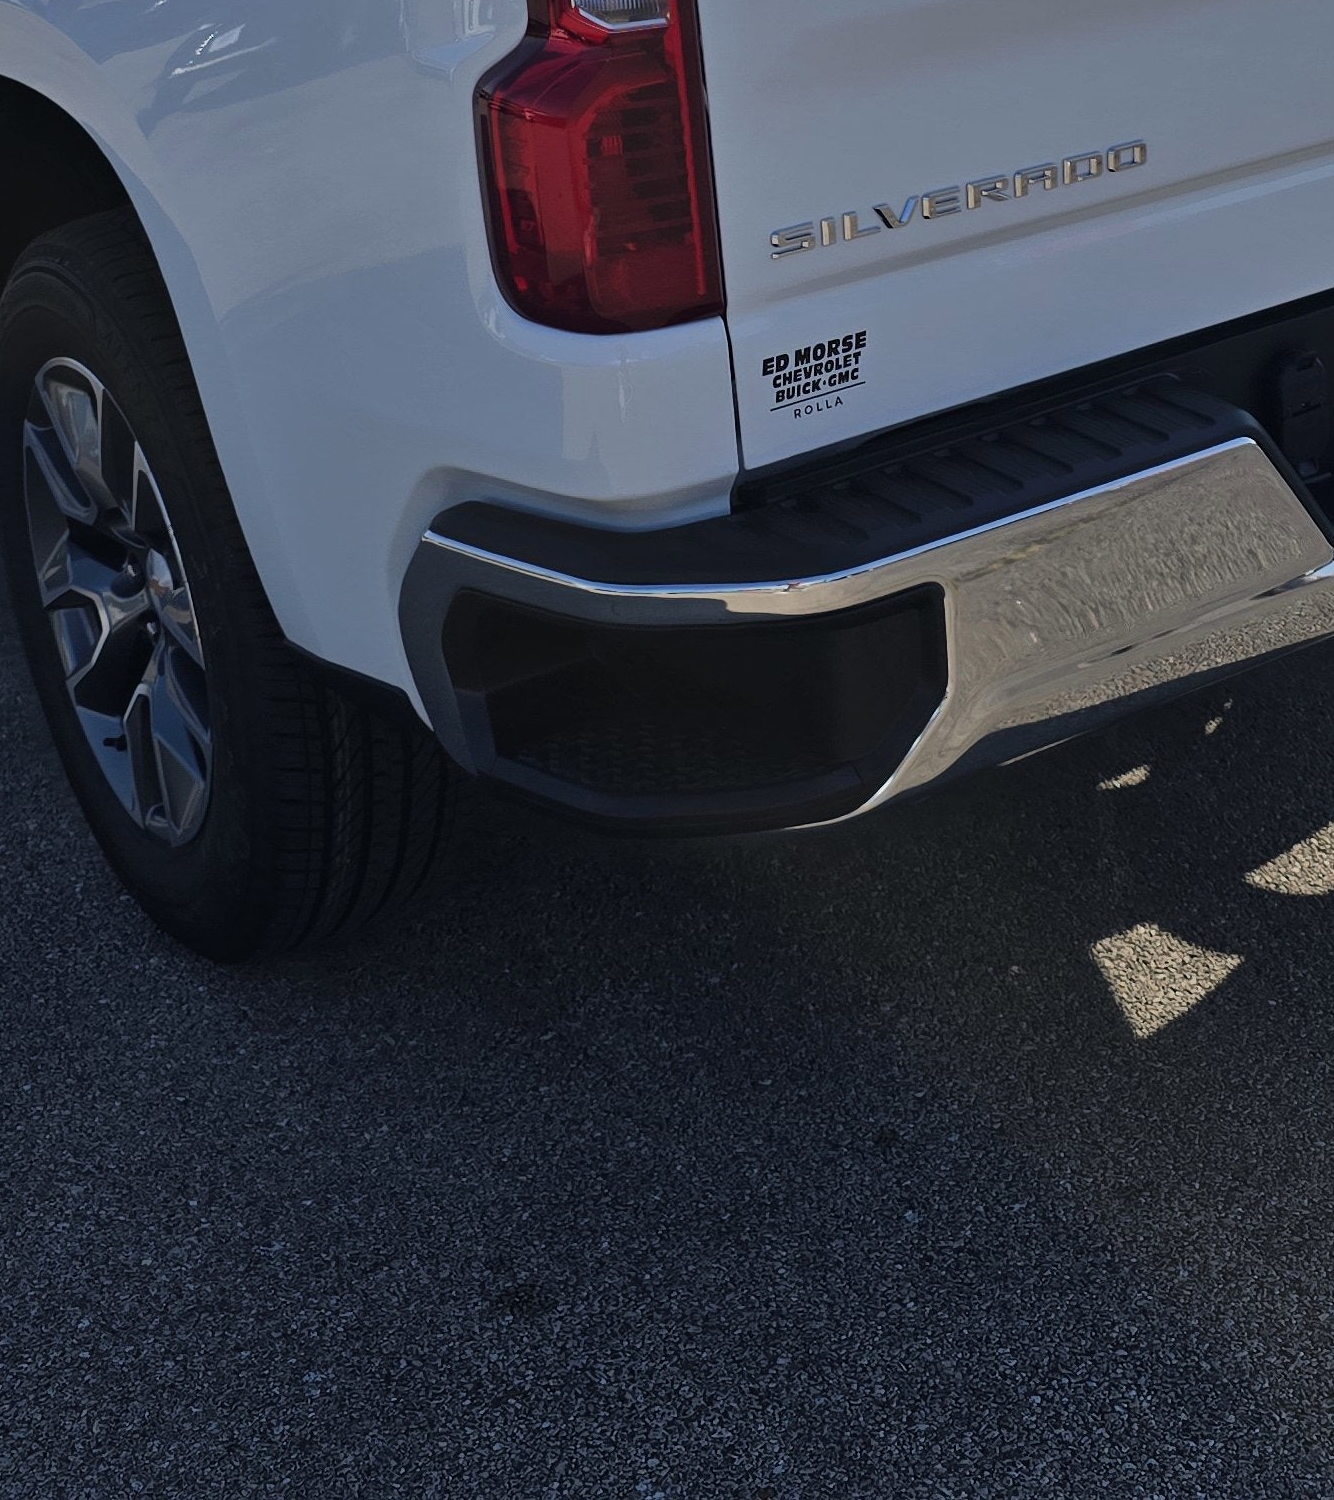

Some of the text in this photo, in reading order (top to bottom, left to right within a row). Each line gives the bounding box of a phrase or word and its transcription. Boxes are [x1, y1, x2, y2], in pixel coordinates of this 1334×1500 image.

[769, 139, 1148, 260] SILVERADO
[762, 330, 867, 376] ED MORSE
[772, 350, 862, 388] CHEVROLET
[793, 396, 843, 419] ROLLA
